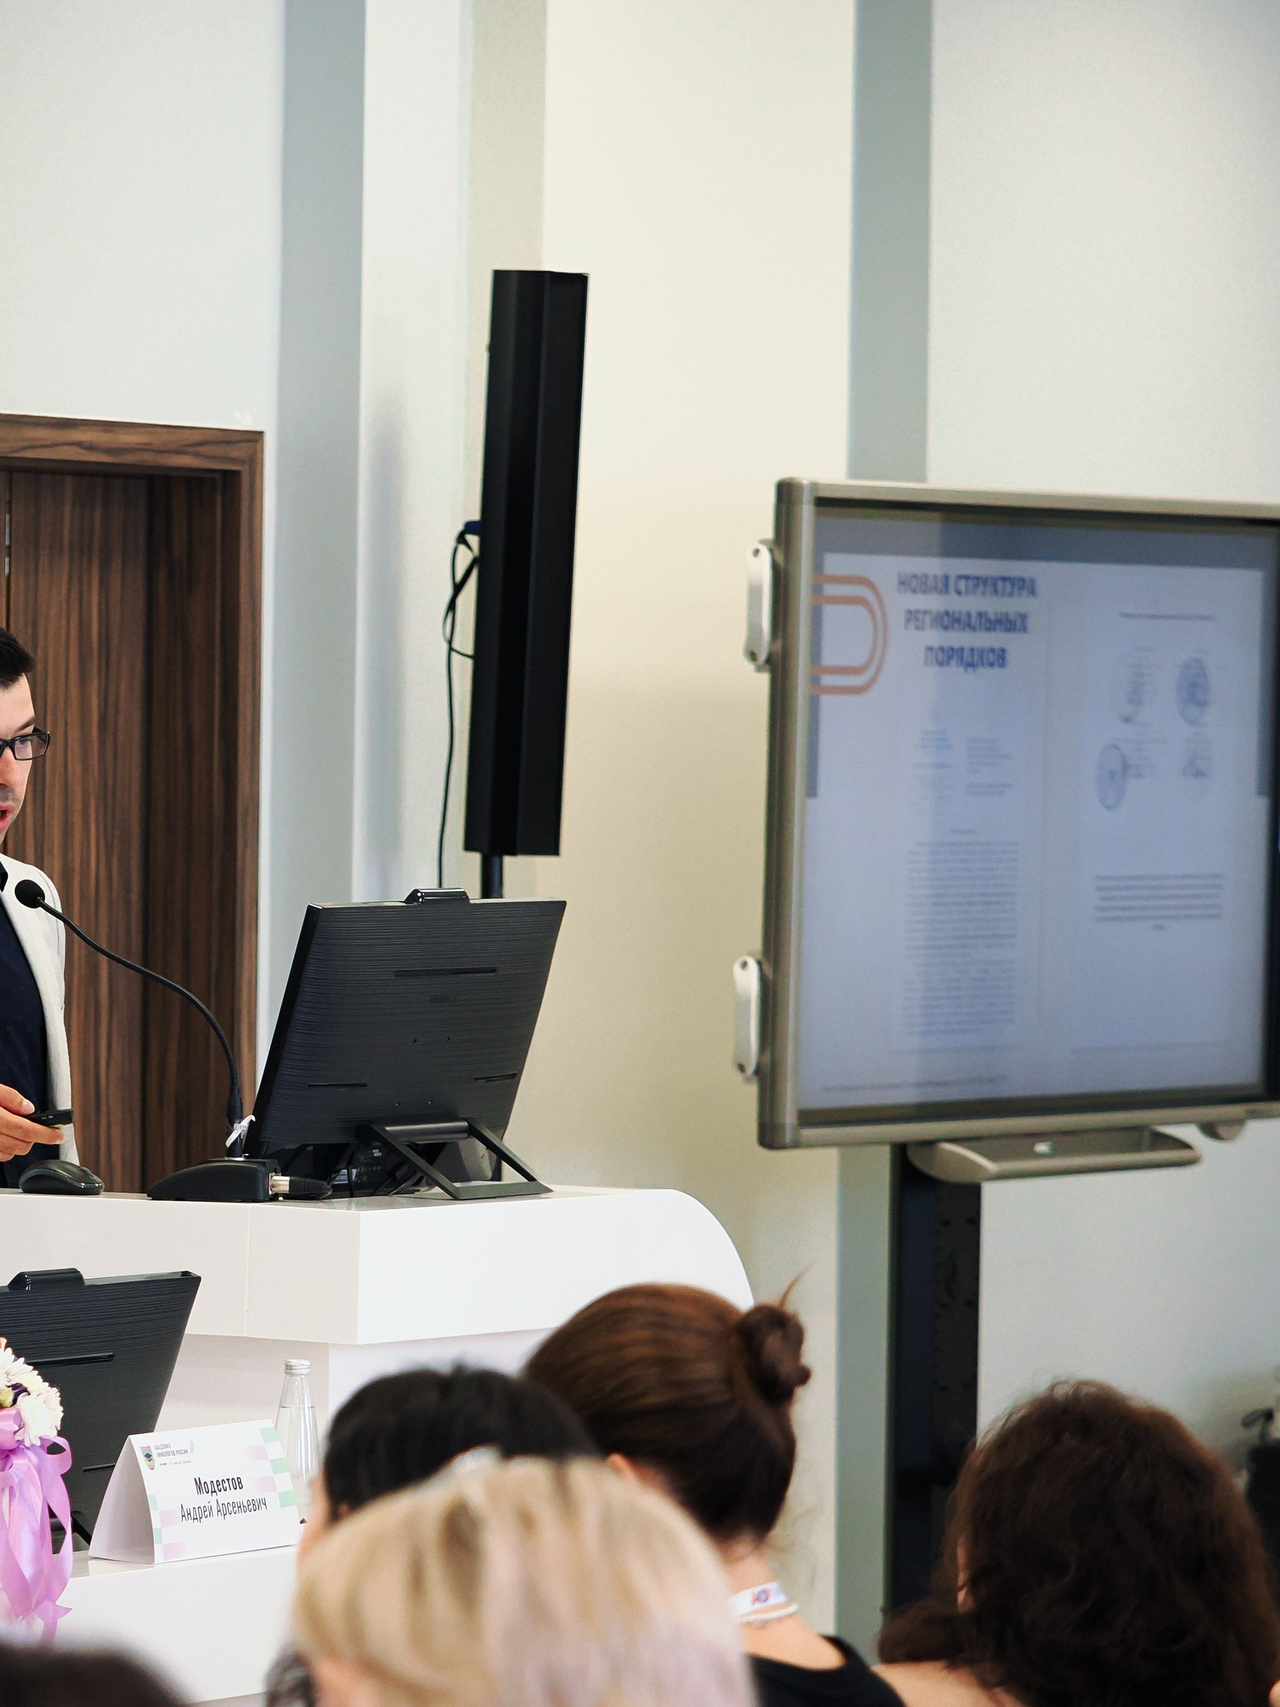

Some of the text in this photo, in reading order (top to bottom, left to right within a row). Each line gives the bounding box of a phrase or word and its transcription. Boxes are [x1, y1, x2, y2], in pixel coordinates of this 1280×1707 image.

[896, 572, 1037, 597] НОВАЯ СТРУКТУРА
[904, 608, 1029, 634] РЕГИОНАЛЬНЫХ
[923, 644, 1007, 672] ПОРЯДКОВ
[194, 1476, 244, 1495] Модестов
[180, 1496, 268, 1523] Андрей Арсеньевич
